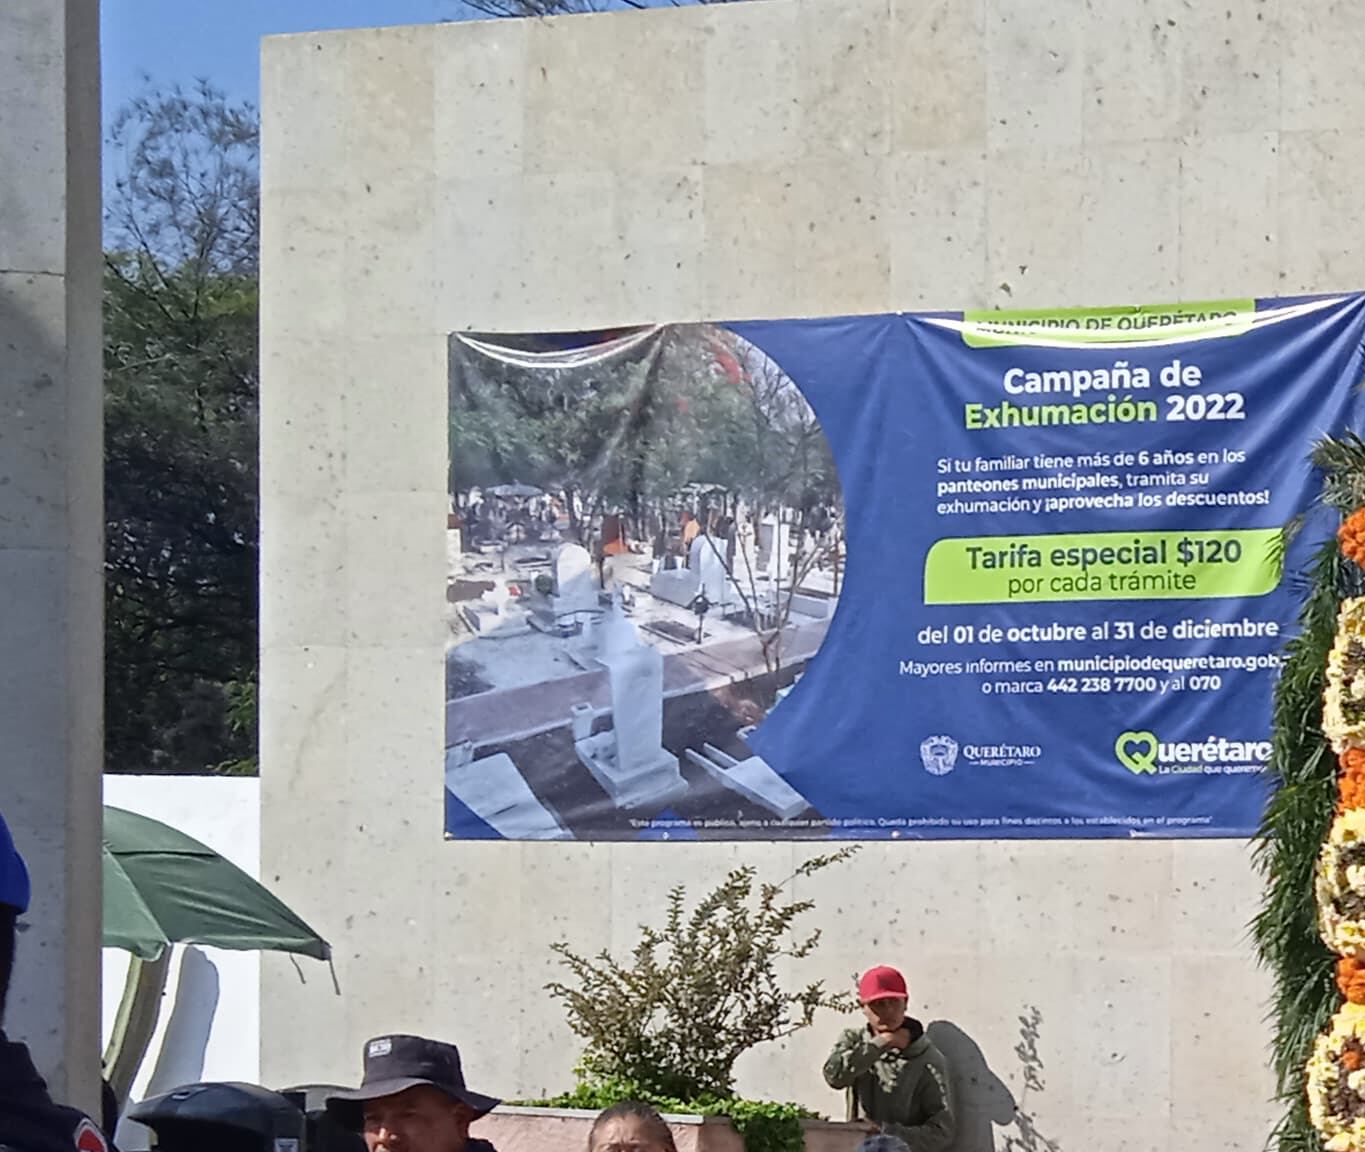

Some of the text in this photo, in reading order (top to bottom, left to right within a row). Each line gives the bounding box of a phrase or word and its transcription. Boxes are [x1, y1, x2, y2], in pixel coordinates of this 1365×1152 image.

[1003, 360, 1202, 396] Campaña de
[965, 393, 1246, 430] Exhumación 2022
[937, 448, 1246, 473] Si tu familiar tiene más de 6 años en los
[937, 471, 1209, 497] panteones municipales, tramita su
[937, 489, 1270, 514] exhumación y ¡aprovecha los descuentos!
[966, 537, 1242, 571] Tarifa especial $120
[1008, 570, 1197, 598] por cada trámite
[918, 619, 1279, 644] del 01 de octubre al 31 de diciembre
[899, 661, 962, 678] Mayores
[966, 658, 1031, 673] informes
[1034, 660, 1055, 672] en
[982, 674, 1222, 695] o marca 442 238 7700 y al 070
[963, 743, 1041, 760] QUERÉTARO
